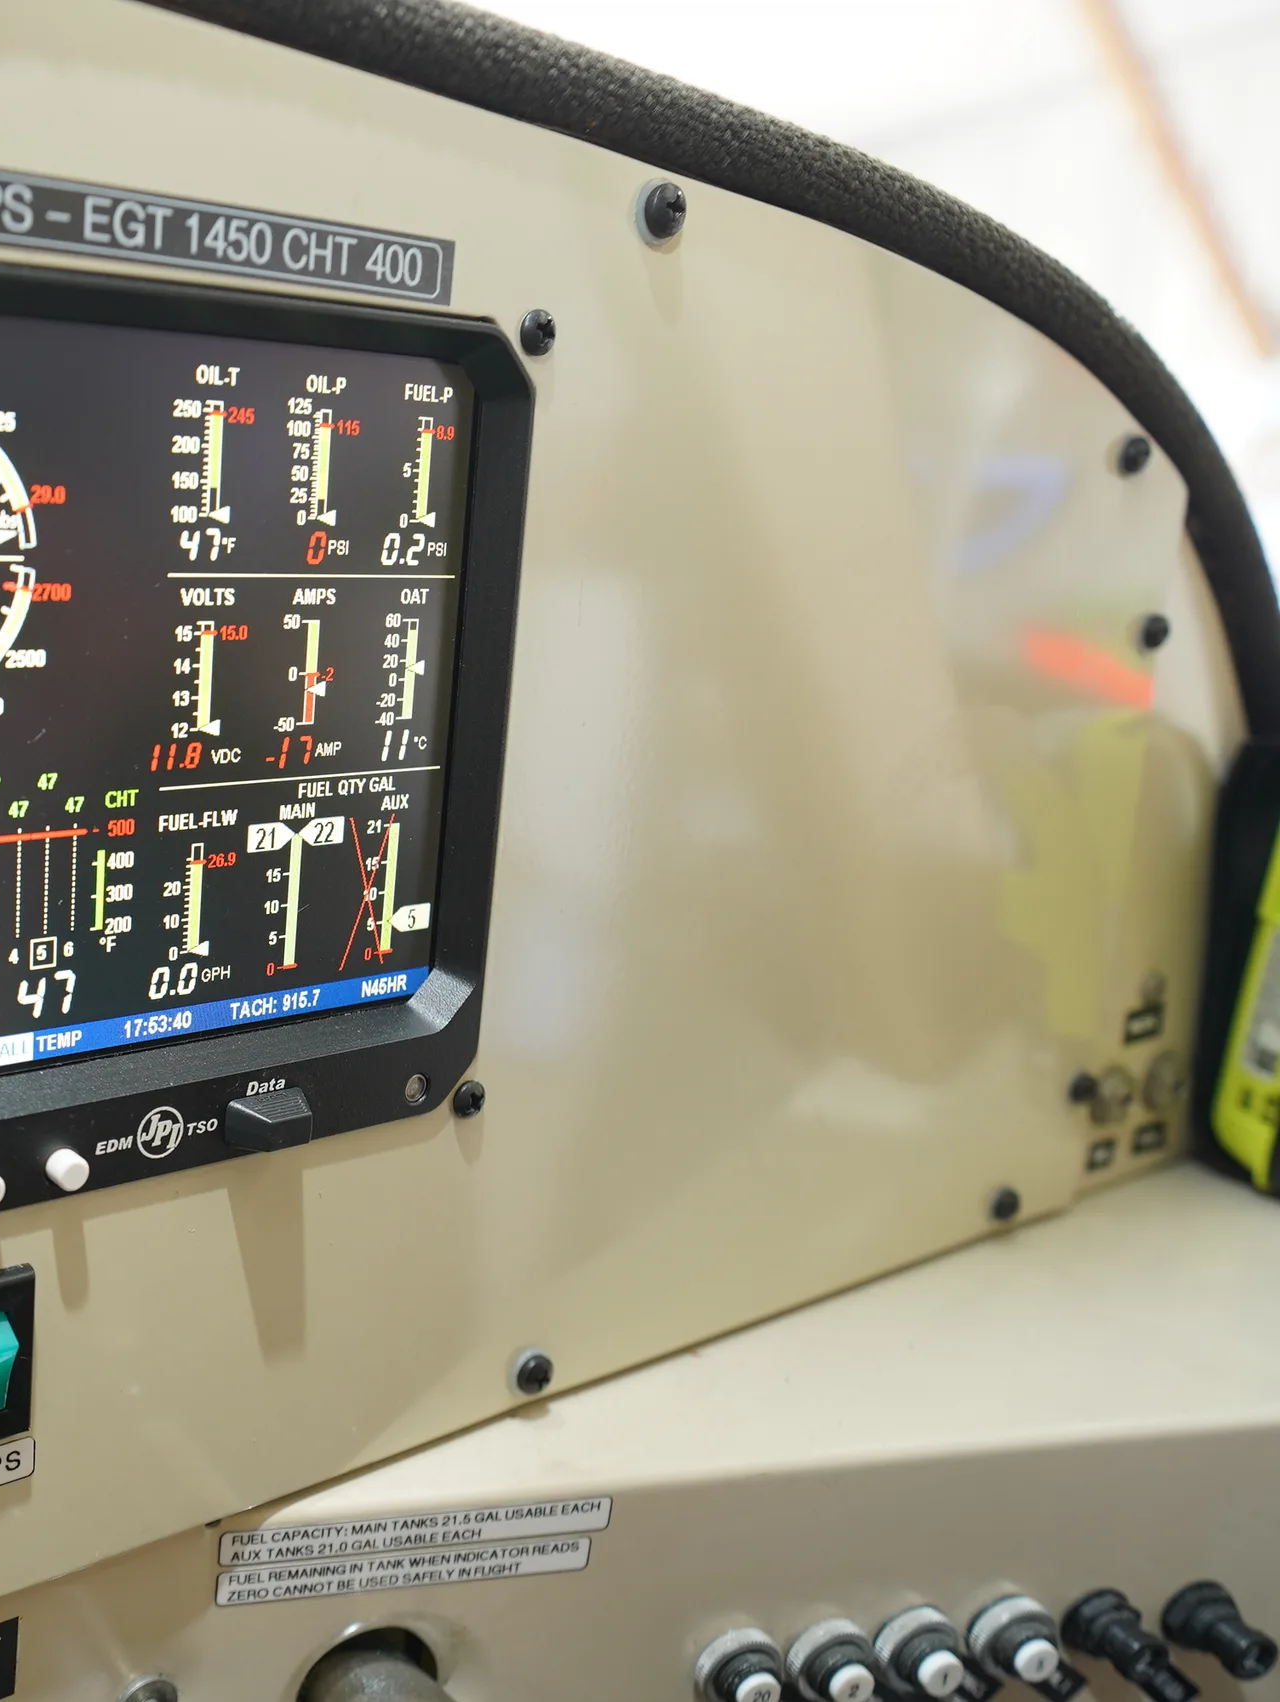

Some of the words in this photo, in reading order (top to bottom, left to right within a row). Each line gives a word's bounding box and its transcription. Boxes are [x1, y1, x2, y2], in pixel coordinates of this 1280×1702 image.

[82, 199, 171, 251] EGT
[184, 215, 272, 266] 1450
[282, 229, 358, 276] CHT
[365, 244, 422, 288] 400
[195, 364, 240, 387] OIL-T
[306, 374, 347, 395] OIL-P
[404, 383, 453, 403] FUEL-P
[173, 399, 202, 418] 250
[287, 398, 313, 414] 125
[228, 407, 256, 425] 245
[286, 420, 311, 437] 100
[337, 420, 360, 436] 115
[436, 425, 455, 440] 8.9
[171, 436, 200, 454] 200
[292, 443, 310, 459] 75
[291, 465, 308, 481] 50
[402, 464, 411, 477] 5
[171, 471, 199, 490] 150
[290, 488, 308, 503] 25
[171, 505, 197, 523] 100
[296, 510, 306, 525] 0
[399, 513, 408, 528] 0
[180, 527, 221, 561] 47
[306, 531, 327, 565] 0
[380, 532, 425, 566] 0.2
[427, 542, 447, 557] PSI
[33, 583, 71, 602] 2700
[180, 588, 235, 606] VOLTS
[292, 588, 336, 606] AMPS
[401, 588, 429, 604] OAT
[283, 614, 300, 630] 50
[385, 613, 401, 627] 60
[175, 625, 193, 642] 15
[220, 625, 248, 641] 15.0
[384, 633, 400, 648] 40
[173, 658, 191, 675] 14
[382, 654, 398, 668] 20
[288, 667, 298, 681] 0
[388, 673, 397, 687] 0
[172, 690, 190, 706] 13
[171, 723, 188, 739] 12
[266, 735, 313, 769] -17
[315, 742, 342, 757] AMP
[381, 729, 410, 762] 11
[150, 741, 203, 771] 11.8
[211, 749, 241, 764] VDC
[37, 772, 58, 791] 47
[298, 782, 333, 799] FUEL
[338, 779, 366, 796] QTY
[369, 776, 396, 793] GAL
[65, 796, 85, 813] 47
[105, 789, 139, 809] CHT
[381, 794, 409, 811] AUX
[8, 800, 29, 819] 47
[279, 802, 315, 821] MAIN
[108, 819, 135, 837] 500
[158, 809, 238, 833] FUEL-FLW
[367, 820, 383, 834] 21
[313, 822, 334, 844] 22
[107, 851, 134, 870] 400
[208, 852, 236, 868] 26.9
[266, 868, 282, 883] 15
[106, 884, 133, 902] 300
[163, 881, 181, 896] 20
[264, 899, 279, 914] 10
[104, 916, 132, 935] 200
[163, 914, 179, 929] 10
[268, 930, 277, 945] 5
[169, 946, 178, 960] 0
[267, 962, 274, 976] 0
[148, 962, 197, 1000] 0.0
[201, 965, 231, 982] GPH
[17, 969, 76, 1018] 47
[0, 1040, 29, 1060] ALL
[36, 1030, 82, 1052] TEMP
[123, 1011, 192, 1038] 17:53:40
[230, 999, 277, 1020] TACH:
[283, 989, 320, 1012] 915.7
[246, 1078, 286, 1096] Data
[95, 1136, 133, 1155] EDM
[187, 1119, 218, 1136] TSO
[232, 1533, 267, 1546] FUEL
[271, 1526, 348, 1543] CAPACITY:
[351, 1520, 387, 1535] MAIN
[392, 1517, 438, 1533] TANKS
[475, 1511, 502, 1523] GAL
[505, 1505, 557, 1521] USABLE
[561, 1501, 601, 1515] EACH
[231, 1550, 261, 1562] AUX
[267, 1545, 314, 1559] TANKS
[318, 1541, 347, 1554] 21.0
[351, 1538, 379, 1550] GAL
[382, 1532, 438, 1548] USABLE
[442, 1529, 482, 1542] EACH
[228, 1573, 264, 1586] FUEL
[268, 1565, 346, 1582] REMAINING
[349, 1562, 363, 1573] IN
[369, 1558, 405, 1570] TANK
[409, 1553, 451, 1569] WHEN
[453, 1547, 529, 1564] INDICATOR
[532, 1541, 579, 1555] READS
[227, 1589, 268, 1602] ZERO
[273, 1582, 333, 1597] CANNOT
[337, 1579, 355, 1591] BE
[359, 1574, 398, 1588] USED
[402, 1568, 455, 1588] SAFELY
[458, 1567, 471, 1578] IN
[474, 1562, 522, 1577] FLIGHT
